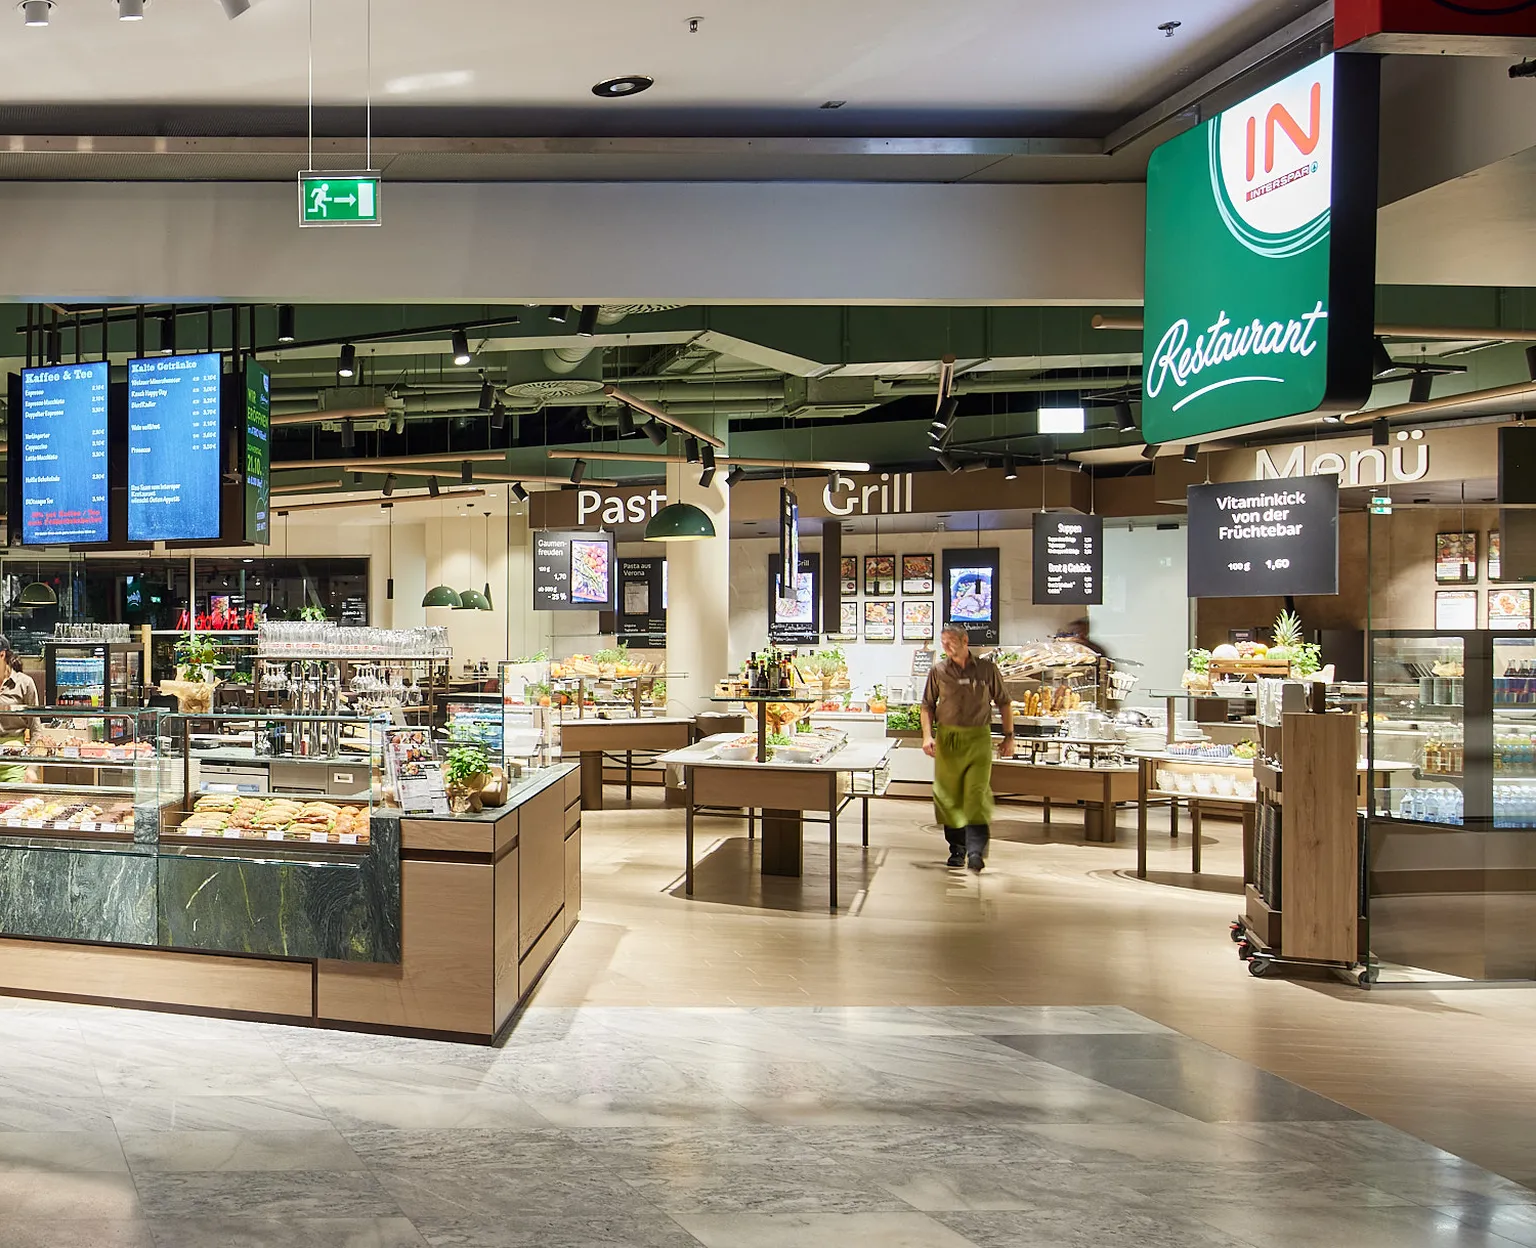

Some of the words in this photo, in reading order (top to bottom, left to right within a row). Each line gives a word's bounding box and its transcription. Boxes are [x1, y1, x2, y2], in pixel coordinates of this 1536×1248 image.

[1246, 82, 1321, 182] IN
[1246, 165, 1310, 202] INTERSPAR
[1147, 301, 1328, 398] Restaurant
[25, 372, 60, 384] Kaffee
[62, 370, 72, 381] &
[73, 369, 93, 380] Tee
[1256, 430, 1429, 485] Menü
[823, 472, 913, 516] Grill
[1216, 491, 1306, 511] Vitaminkick
[577, 489, 667, 525] Past
[1231, 511, 1260, 524] von
[1263, 509, 1290, 521] der
[1057, 523, 1082, 535] Suppen
[1219, 523, 1303, 540] Früchtebar
[538, 539, 568, 547] Gaumen-
[538, 548, 564, 556] freuden
[1228, 562, 1243, 571] 100
[1244, 562, 1251, 572] g
[1265, 559, 1290, 571] 1,60
[553, 573, 567, 581] 1,70
[560, 592, 567, 601] %
